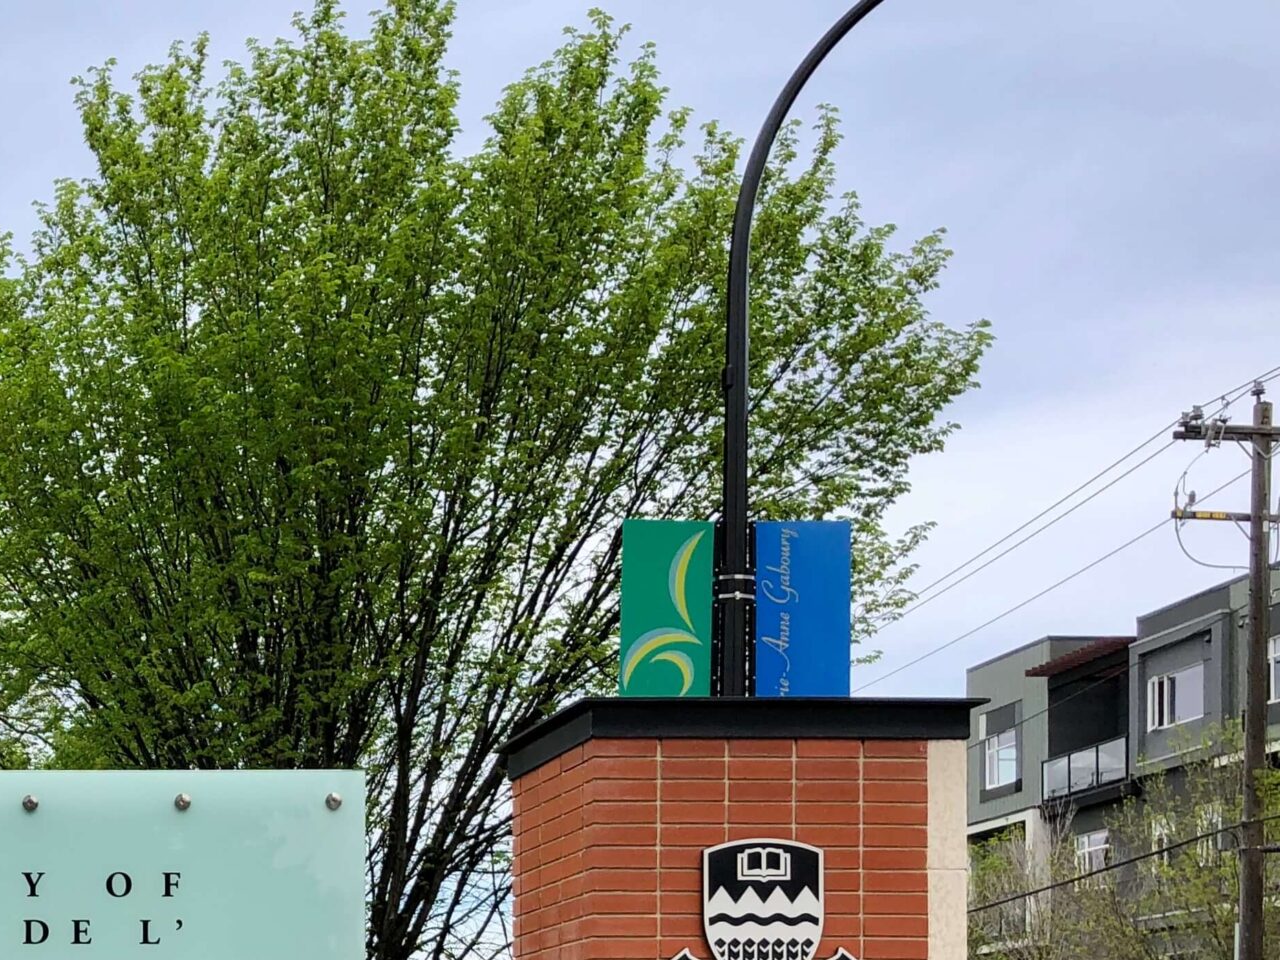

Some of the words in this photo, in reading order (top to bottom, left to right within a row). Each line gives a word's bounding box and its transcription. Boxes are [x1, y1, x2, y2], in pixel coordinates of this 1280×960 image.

[761, 528, 799, 605] Gaboury
[105, 871, 181, 898] OF
[22, 919, 92, 945] DE
